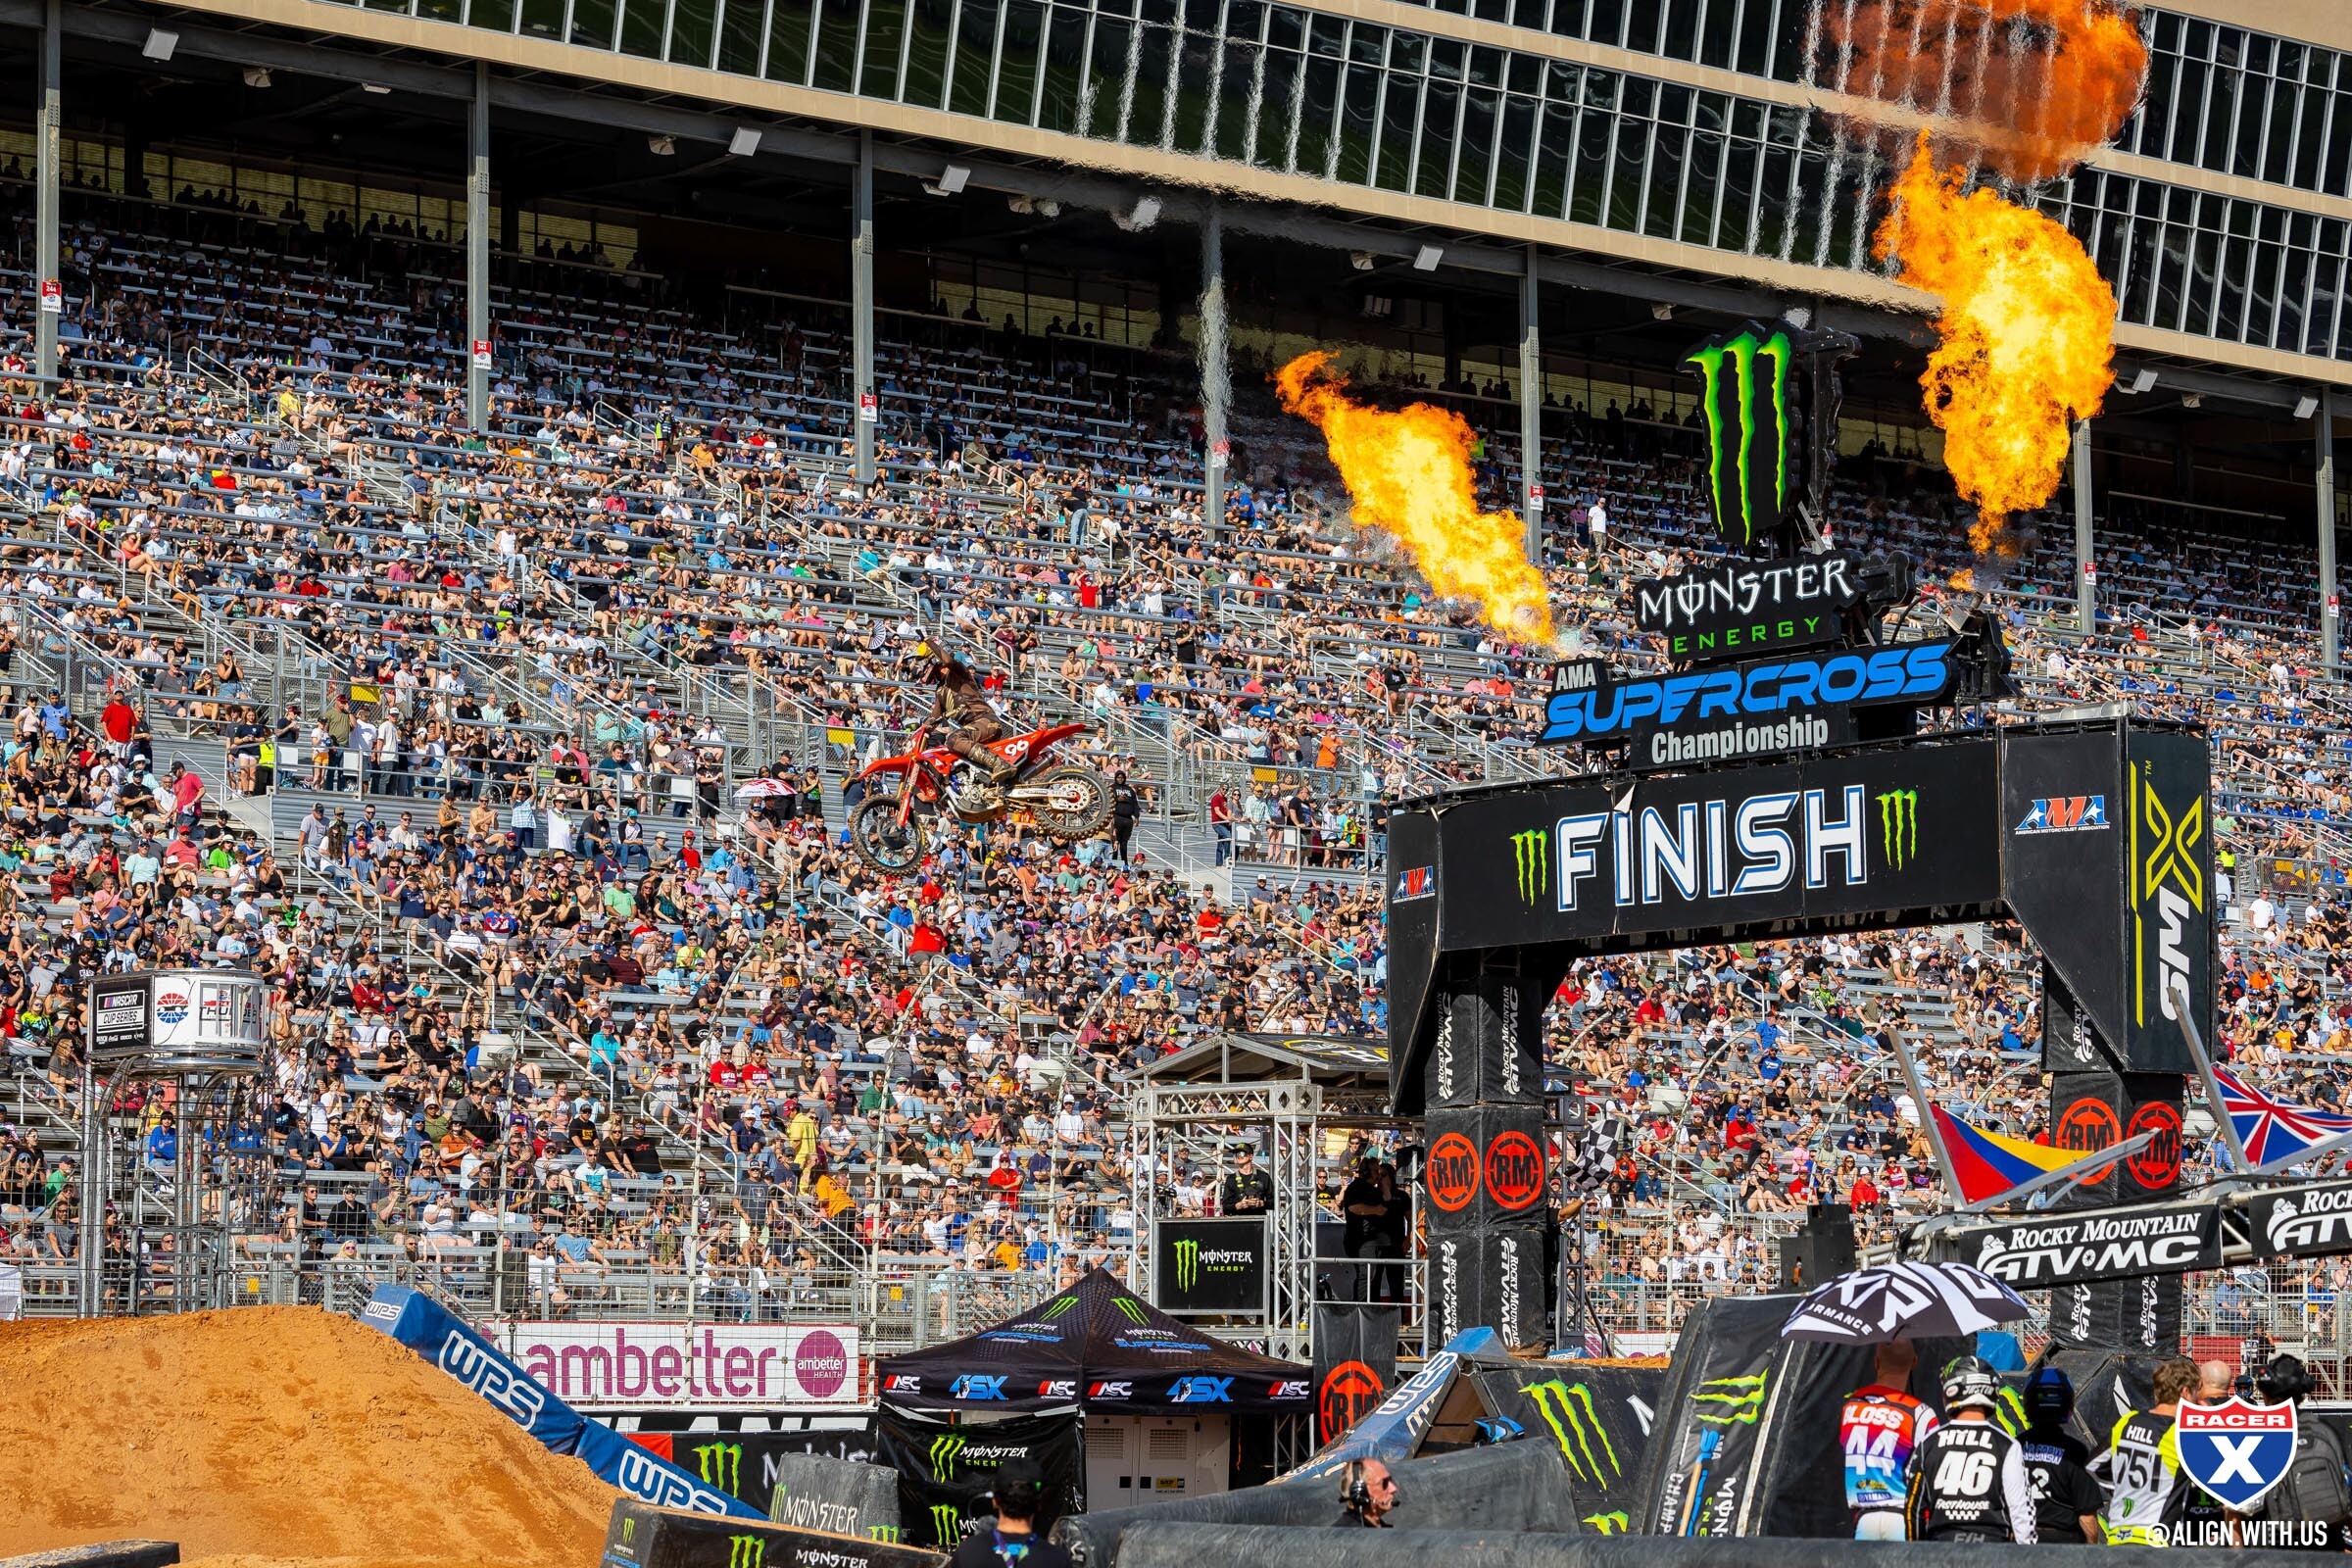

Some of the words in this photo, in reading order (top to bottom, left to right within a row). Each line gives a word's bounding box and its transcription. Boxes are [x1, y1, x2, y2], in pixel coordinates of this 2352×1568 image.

[1674, 616, 1820, 654] ENERGY
[1541, 643, 1952, 740] SUPERCROSS
[1556, 662, 1597, 691] AMA
[1004, 740, 1029, 757] 96
[1651, 714, 1829, 764] Championship
[2014, 795, 2111, 831] AMA
[1557, 784, 1867, 912] FINISH
[1393, 865, 1435, 900] AMA
[103, 1012, 116, 1023] CUP
[117, 1010, 138, 1023] SERIES
[113, 995, 138, 1007] NASCAR
[1438, 1156, 1469, 1188] RM
[1497, 1155, 1531, 1187] RM
[2009, 1225, 2079, 1251] ROCKY
[2082, 1212, 2203, 1242] MOUNTAIN
[1510, 1255, 1519, 1294] ROCKY
[367, 1301, 401, 1321] WPS
[2072, 1285, 2082, 1322] ROCKY
[2140, 1290, 2149, 1327] ROCKY
[1510, 1294, 1520, 1348] MOUNTAIN
[526, 1328, 776, 1397] ambetter
[797, 1355, 845, 1373] ambetter
[439, 1330, 545, 1432] WPS
[892, 1376, 921, 1391] ASC
[1047, 1381, 1077, 1396] ASC
[1097, 1382, 1133, 1396] ASC
[1277, 1381, 1310, 1396] ASC
[1963, 1385, 1994, 1396] JUSTIN
[1845, 1425, 1899, 1477] 44
[1937, 1430, 1993, 1448] HILL
[2126, 1425, 2153, 1445] HILL
[1934, 1450, 1997, 1496] 46
[1936, 1499, 1989, 1510] FASTHOUSE
